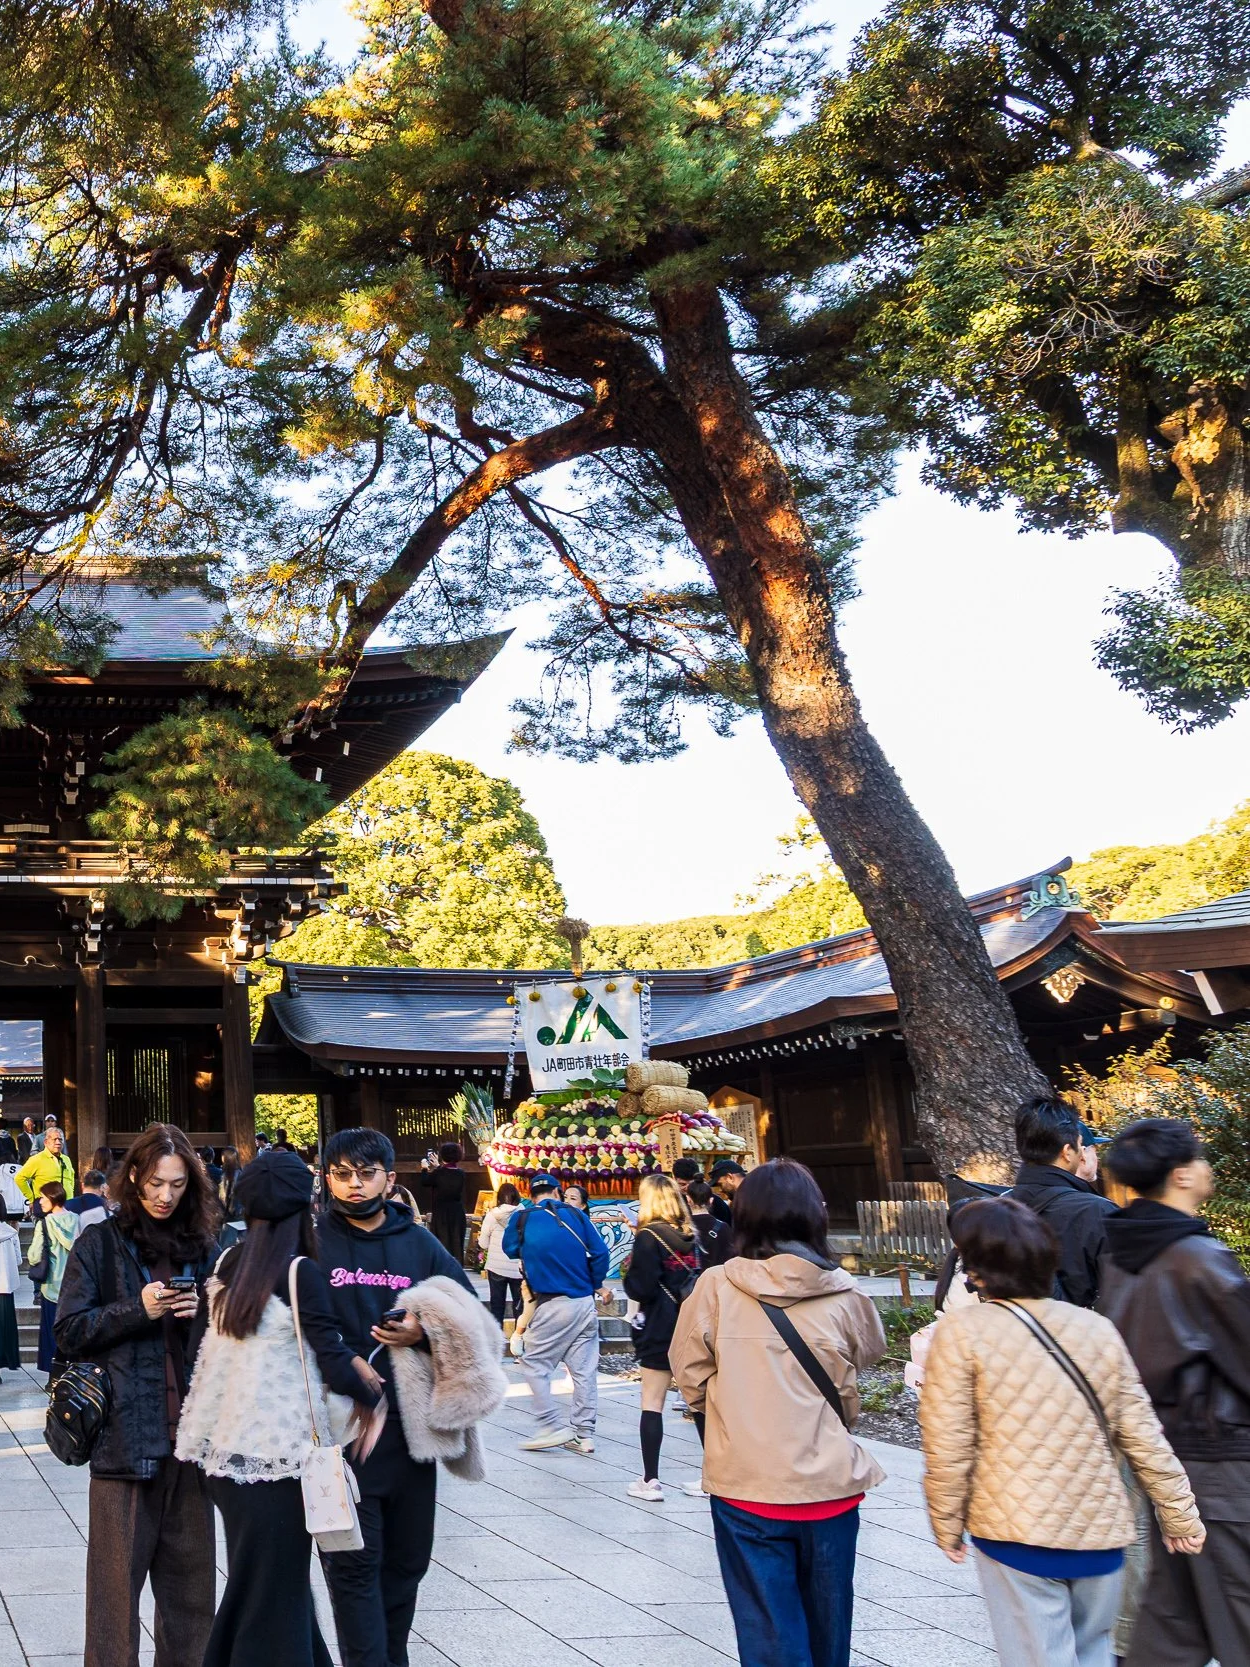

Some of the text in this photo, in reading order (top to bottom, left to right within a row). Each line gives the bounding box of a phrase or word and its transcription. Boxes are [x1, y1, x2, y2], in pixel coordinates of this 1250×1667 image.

[542, 1052, 630, 1073] JA町田市青壮年部会
